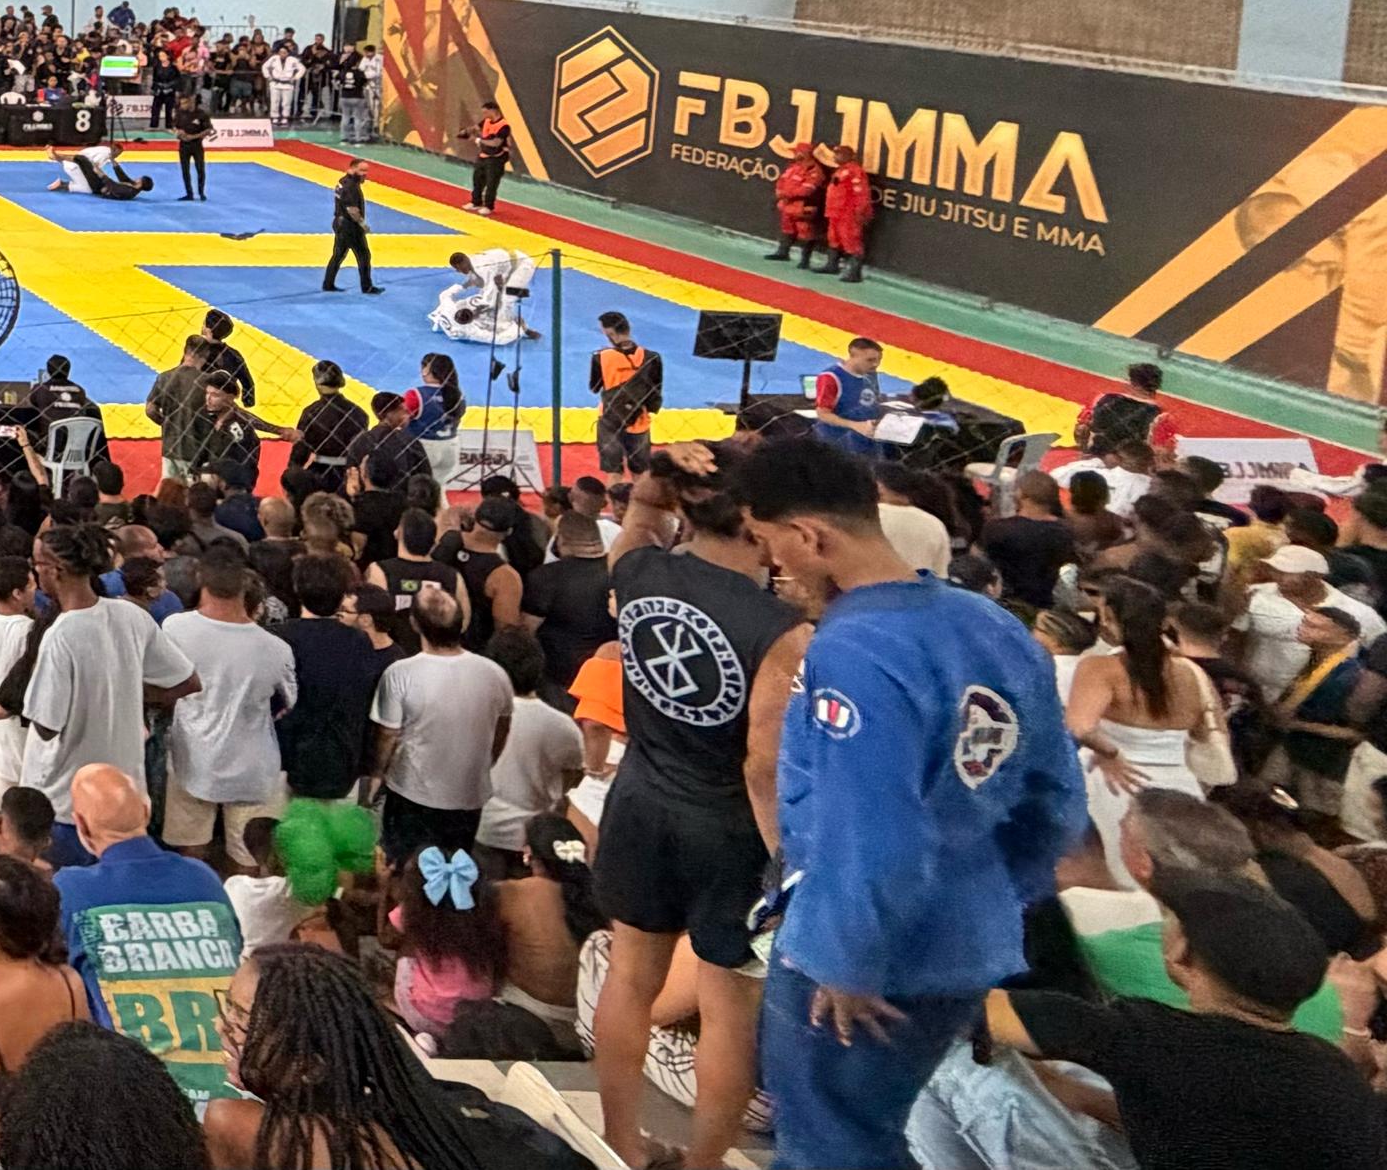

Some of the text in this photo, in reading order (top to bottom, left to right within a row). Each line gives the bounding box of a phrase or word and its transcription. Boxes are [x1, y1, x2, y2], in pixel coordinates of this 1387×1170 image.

[75, 109, 91, 133] 8
[220, 128, 270, 138] FBJJMMA
[673, 71, 1108, 224] FBJJMMA
[671, 143, 780, 181] FEDERAÇÃO
[900, 192, 937, 217] JIU
[939, 200, 1007, 232] JITSU
[1013, 216, 1030, 239] E
[1036, 221, 1107, 257] MMA
[99, 909, 219, 943] BARBA
